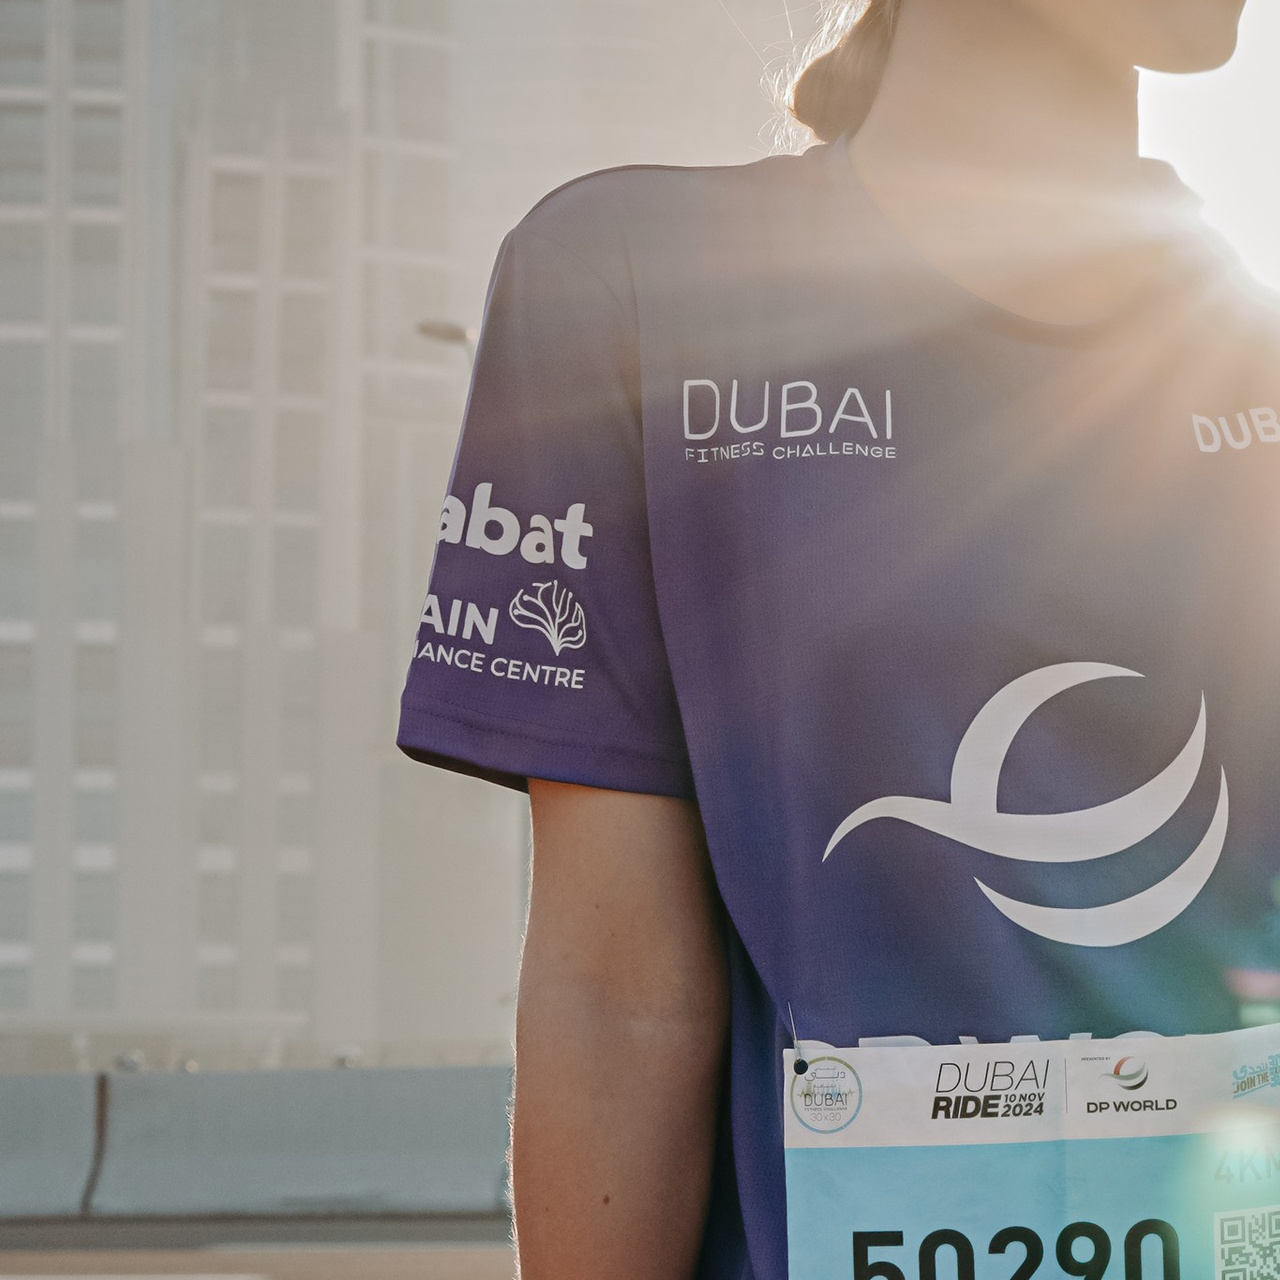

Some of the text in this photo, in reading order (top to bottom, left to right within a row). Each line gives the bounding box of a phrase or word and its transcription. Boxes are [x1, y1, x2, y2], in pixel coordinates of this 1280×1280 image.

[683, 379, 892, 440] DUBAI
[685, 441, 896, 462] FITNESS CHALLENGE
[491, 657, 586, 689] CENTRE
[935, 1058, 1050, 1093] DUBAI
[1233, 1076, 1256, 1094] JOIN
[804, 1093, 848, 1107] DUBAI
[931, 1092, 1046, 1119] RIDE 10 NOV
[1001, 1103, 1045, 1118] 2024
[1086, 1099, 1178, 1114] DP WORLD
